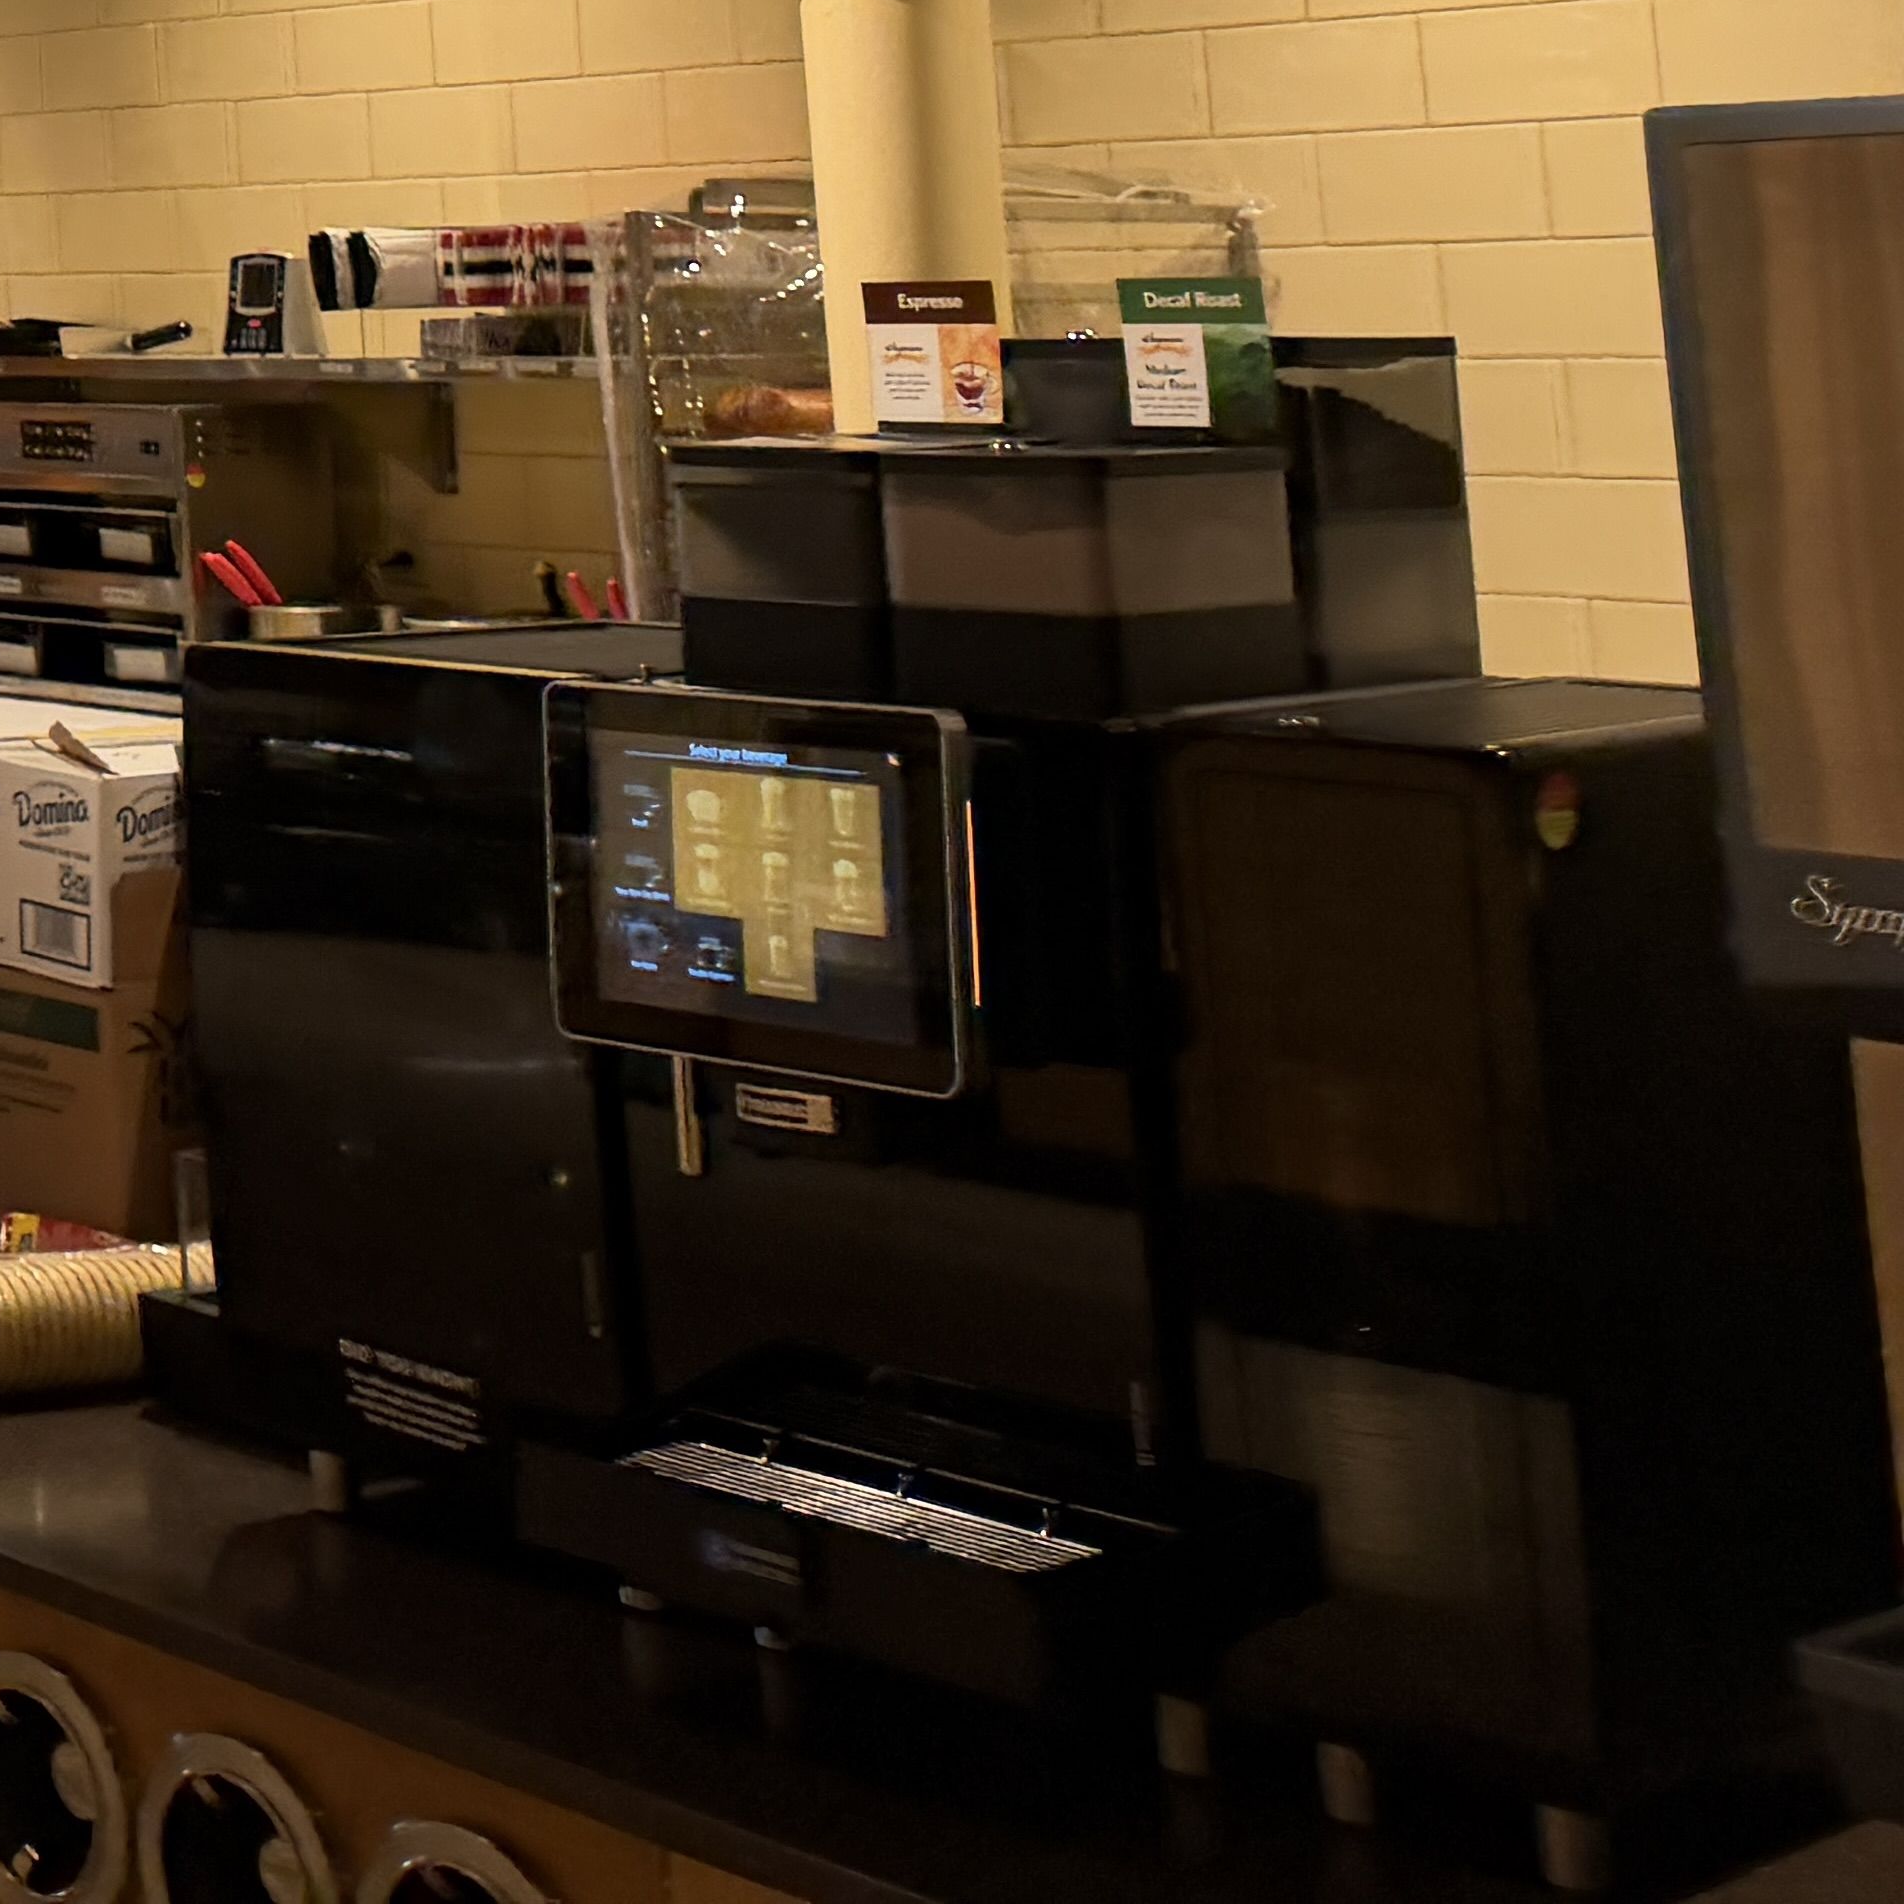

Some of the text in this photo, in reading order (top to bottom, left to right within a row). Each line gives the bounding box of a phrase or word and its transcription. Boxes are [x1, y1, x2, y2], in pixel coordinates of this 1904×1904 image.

[897, 293, 964, 312] Espresso
[1143, 291, 1242, 309] Decaf Roast
